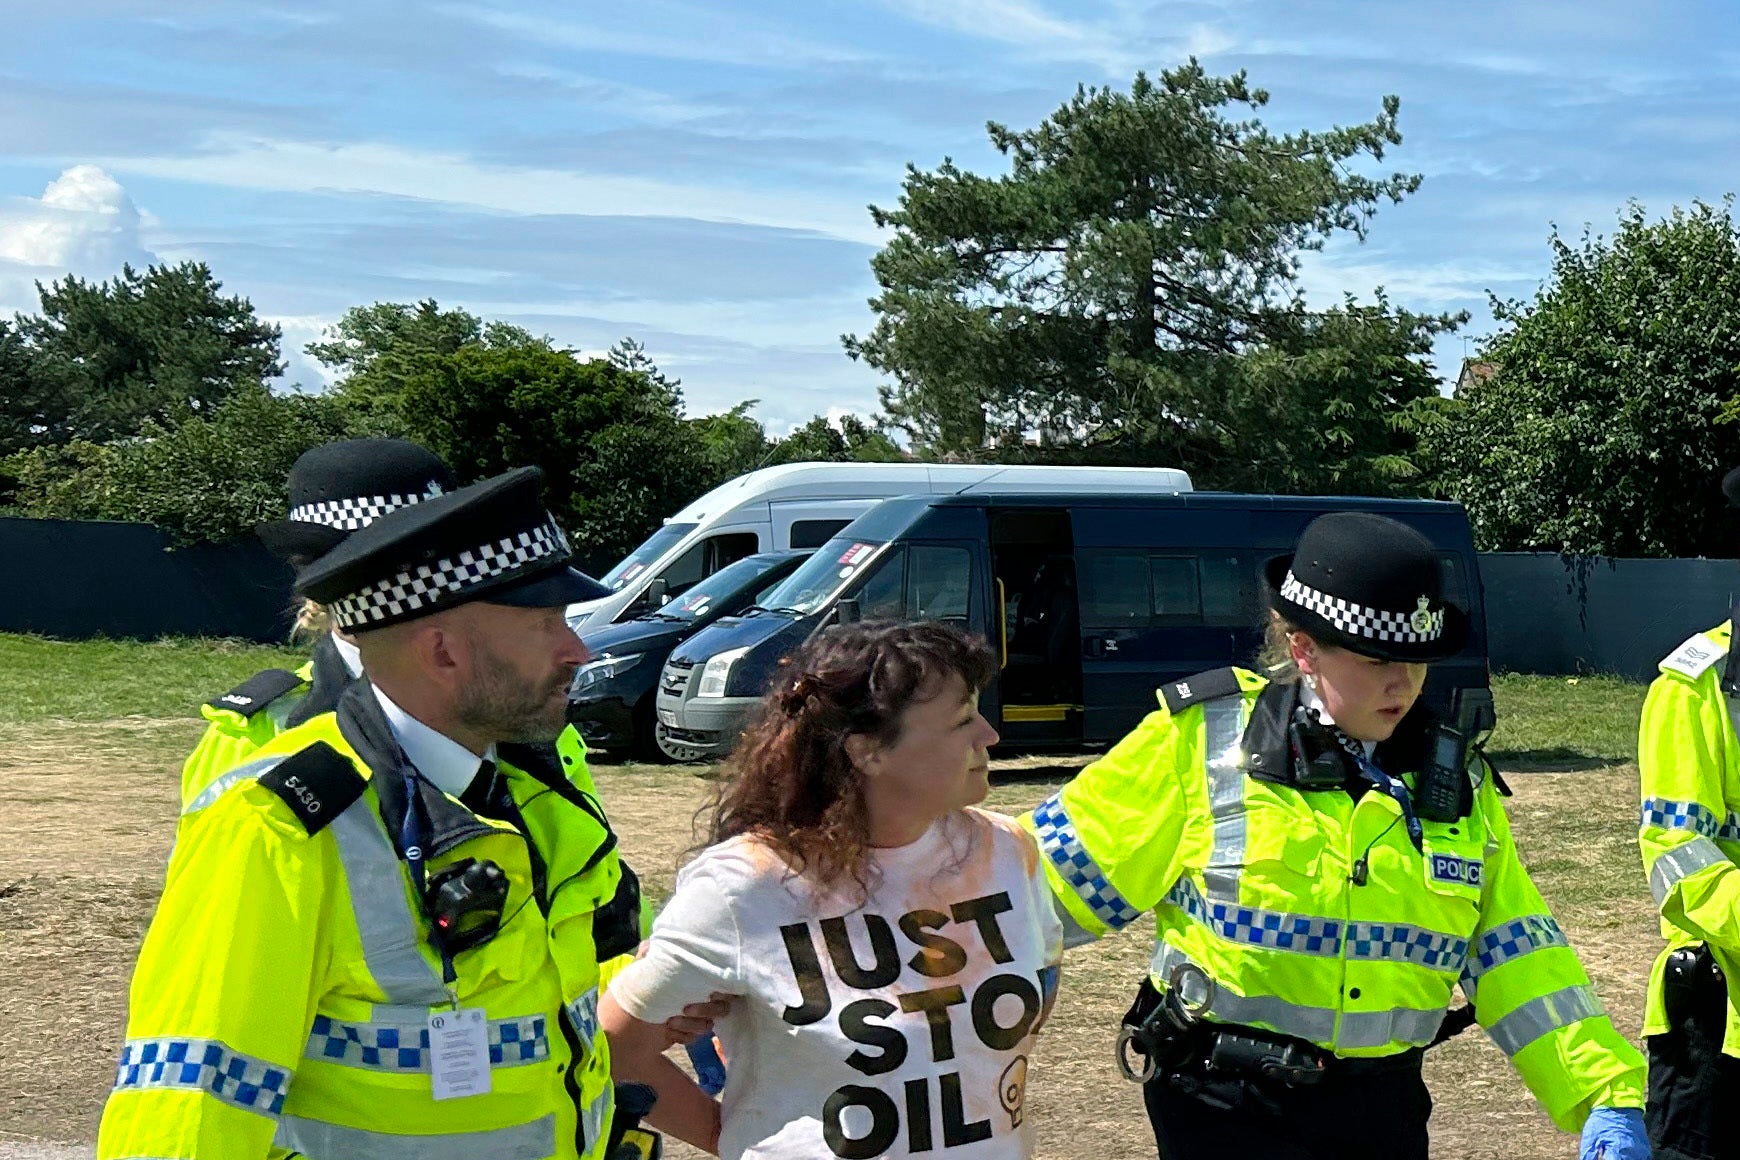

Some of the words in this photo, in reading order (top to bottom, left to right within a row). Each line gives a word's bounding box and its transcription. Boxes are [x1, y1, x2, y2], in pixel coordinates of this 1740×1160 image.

[285, 775, 321, 813] 5430
[779, 891, 1015, 1027] JUST
[822, 1071, 993, 1160] OIL
